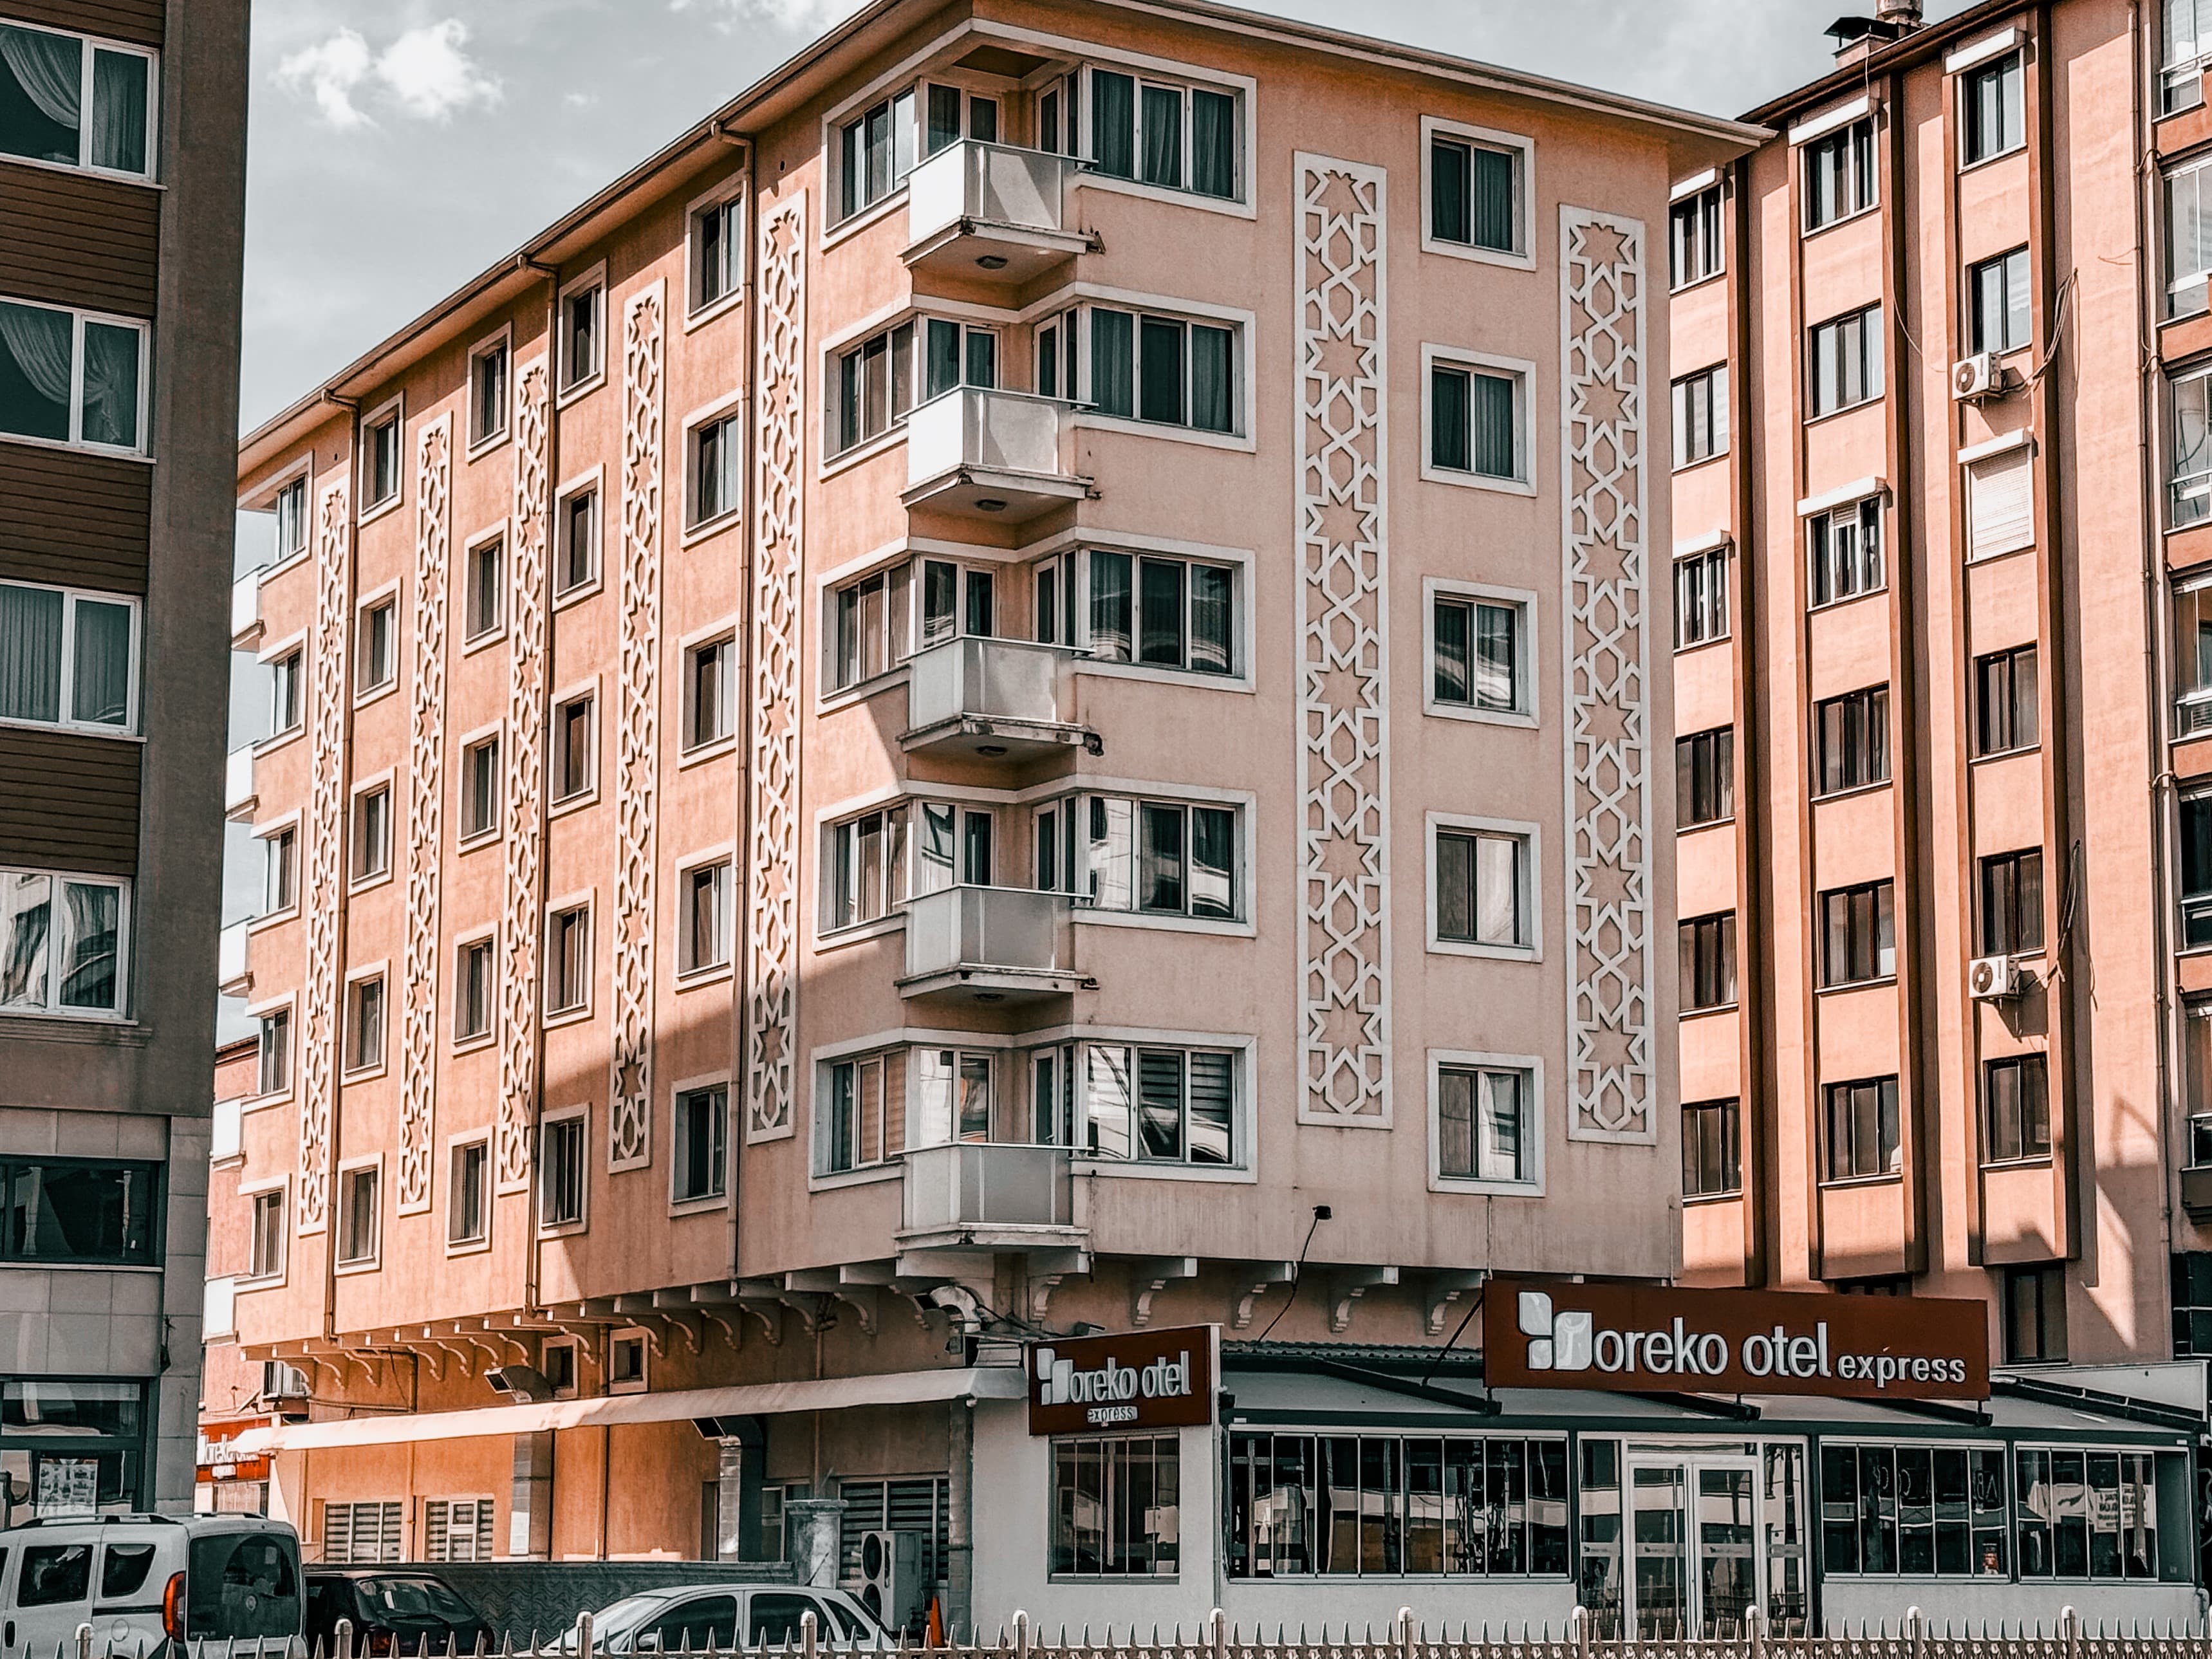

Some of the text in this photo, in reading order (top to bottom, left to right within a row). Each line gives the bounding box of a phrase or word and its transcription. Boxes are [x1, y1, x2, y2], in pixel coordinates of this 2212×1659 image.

[1142, 1350, 1192, 1398] otel
[1594, 1317, 1967, 1388] oreko otel express
[1087, 1405, 1139, 1427] express
